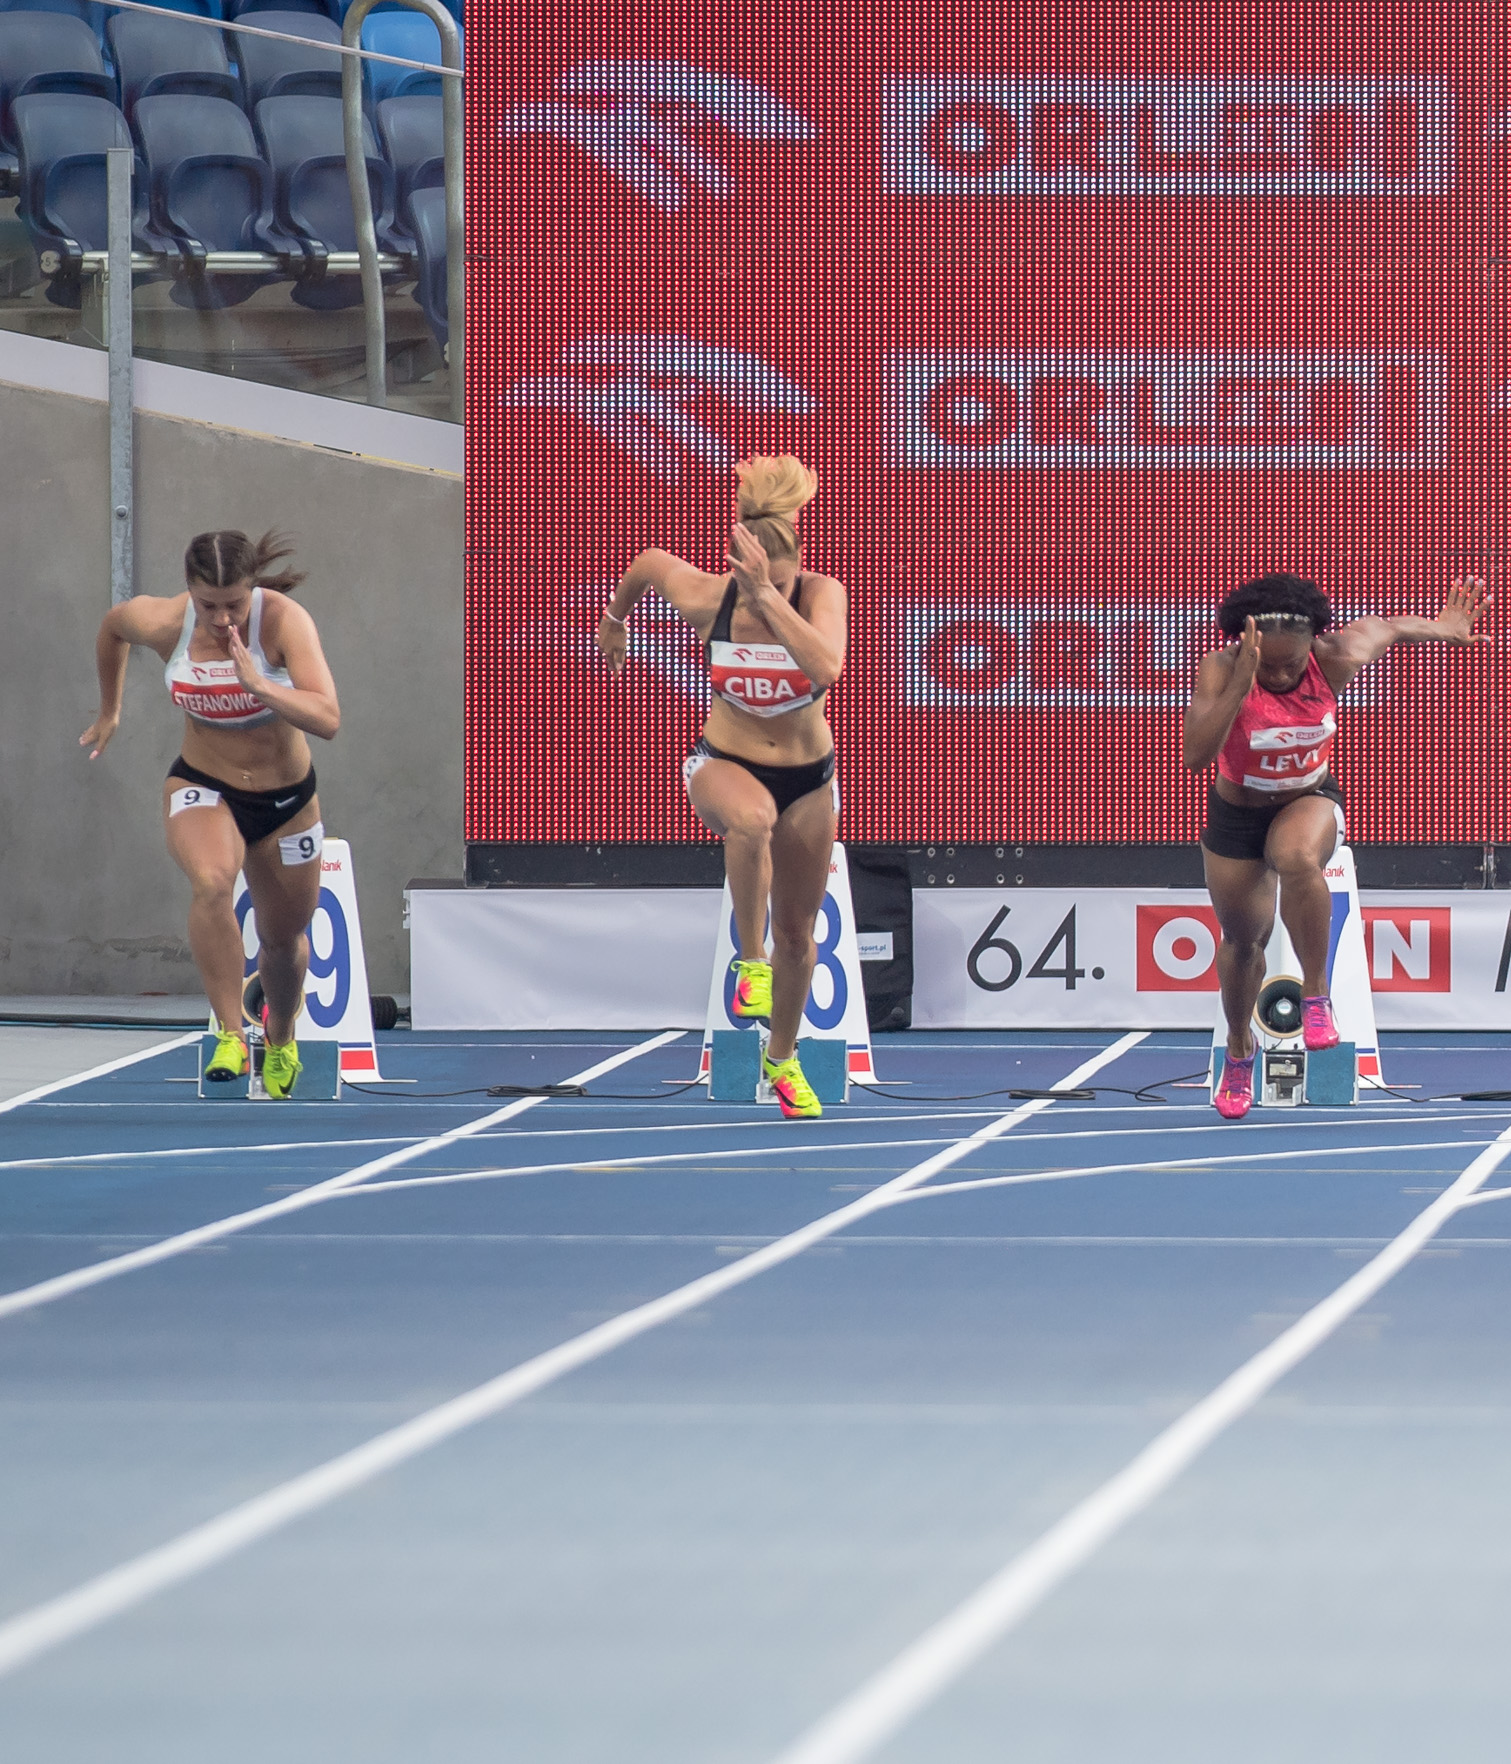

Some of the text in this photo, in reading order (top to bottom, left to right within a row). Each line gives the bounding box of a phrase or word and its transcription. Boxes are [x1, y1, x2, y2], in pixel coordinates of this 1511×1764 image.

[756, 652, 786, 661] ORLEN
[933, 619, 1194, 691] ORL
[724, 676, 797, 699] CIBA
[174, 690, 262, 712] STEFANOWIC
[1260, 742, 1326, 772] LEVY
[184, 789, 201, 806] 9
[298, 835, 316, 859] 9
[321, 859, 342, 872] lanik
[1323, 865, 1345, 877] lanik
[305, 886, 351, 1028] 9
[966, 903, 1106, 993] 64.
[803, 890, 848, 1030] 8
